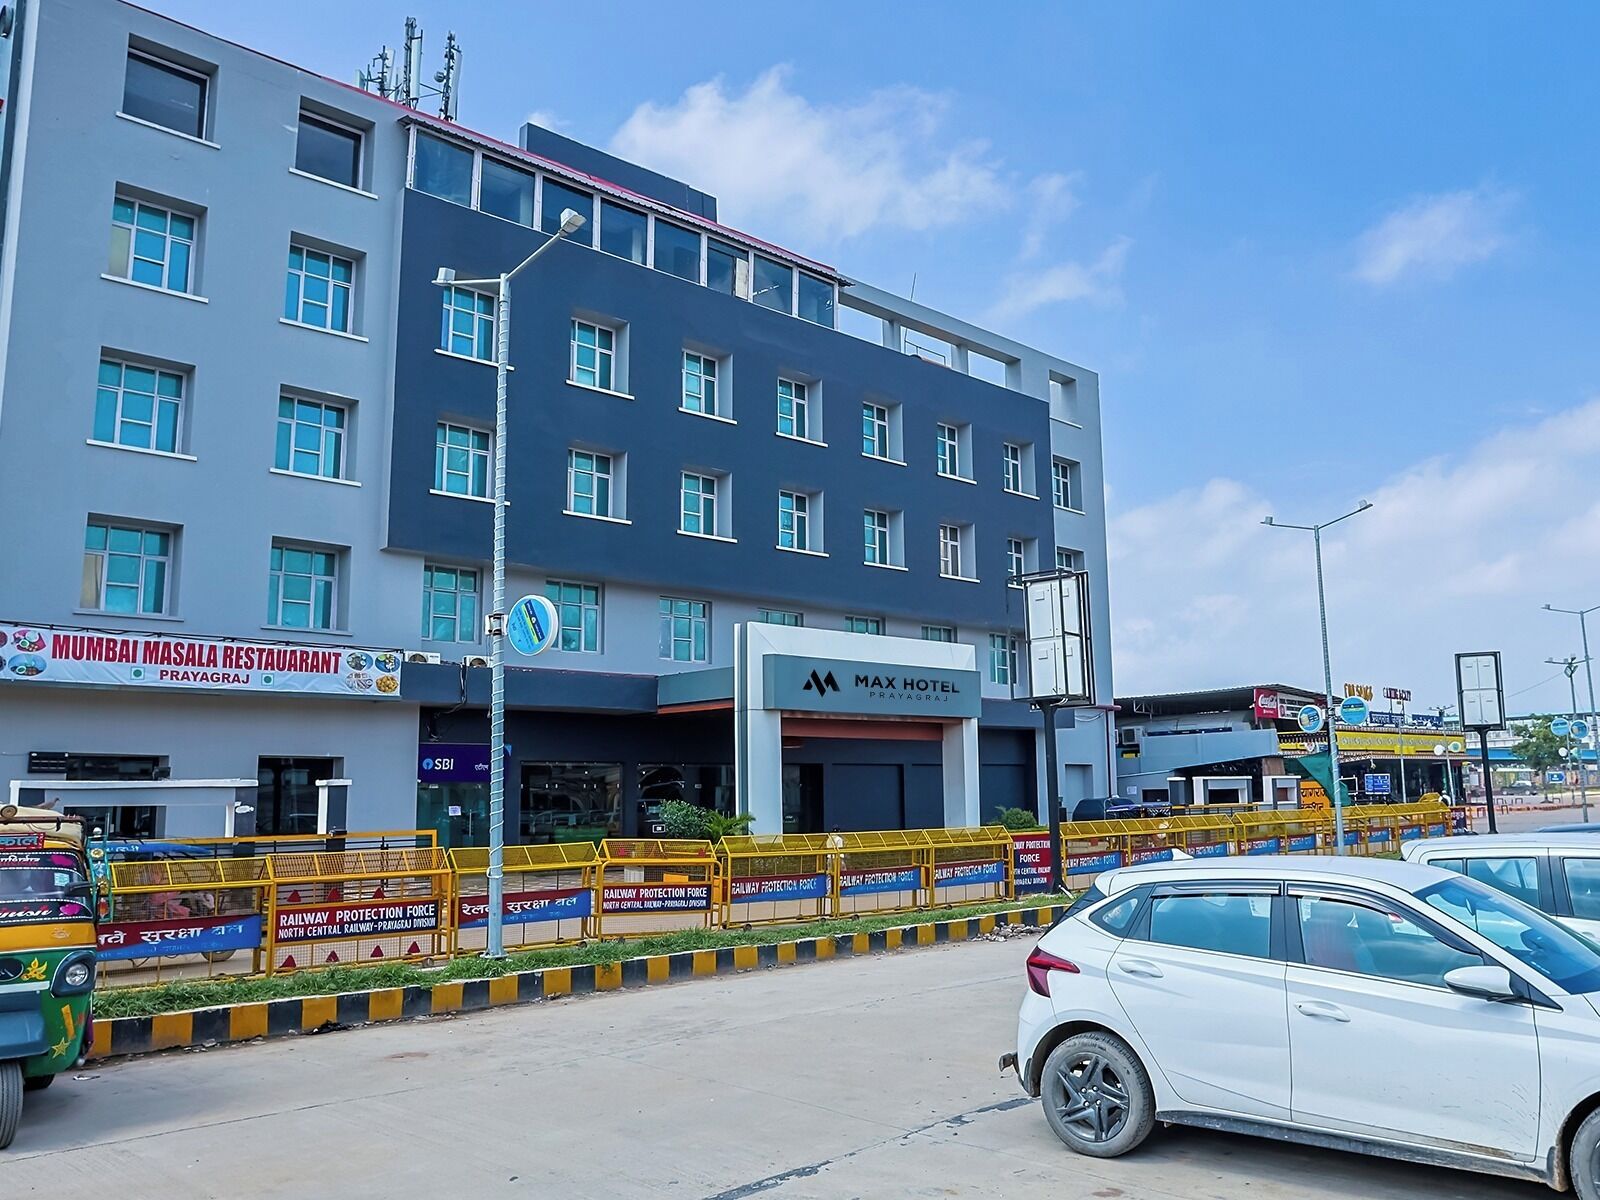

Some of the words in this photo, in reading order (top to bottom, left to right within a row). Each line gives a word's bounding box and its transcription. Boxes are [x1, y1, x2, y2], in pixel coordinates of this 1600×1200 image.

[52, 634, 137, 664] MUMBAI
[142, 640, 218, 669] MASALA
[222, 646, 342, 674] RESTAUARANT
[159, 669, 250, 685] PRAYAGRAJ
[855, 674, 896, 689] MAX
[903, 677, 960, 693] HOTEL
[869, 691, 948, 702] PRAYAGRAJ
[434, 758, 454, 770] SBI
[1020, 854, 1040, 863] FORCE
[865, 872, 896, 885] PROTECTION
[898, 871, 914, 881] FORCE
[604, 889, 636, 899] RAILWAY
[640, 887, 685, 898] PROTECTION
[687, 887, 707, 897] FORCE
[731, 882, 760, 894] RAILWAY
[761, 880, 797, 893] PROTECTION
[800, 878, 817, 889] FORCE
[506, 899, 550, 914] सुरक्षा
[603, 901, 619, 909] NORTH
[620, 900, 643, 909] CENTRAL
[280, 911, 329, 927] RAILWAY
[336, 906, 403, 922] PROTECTION
[406, 903, 435, 918] FORCE
[278, 926, 304, 939] NORTH
[307, 924, 341, 937] CENTRAL
[413, 917, 436, 928] DIVISION
[140, 927, 203, 945] सुरक्षा
